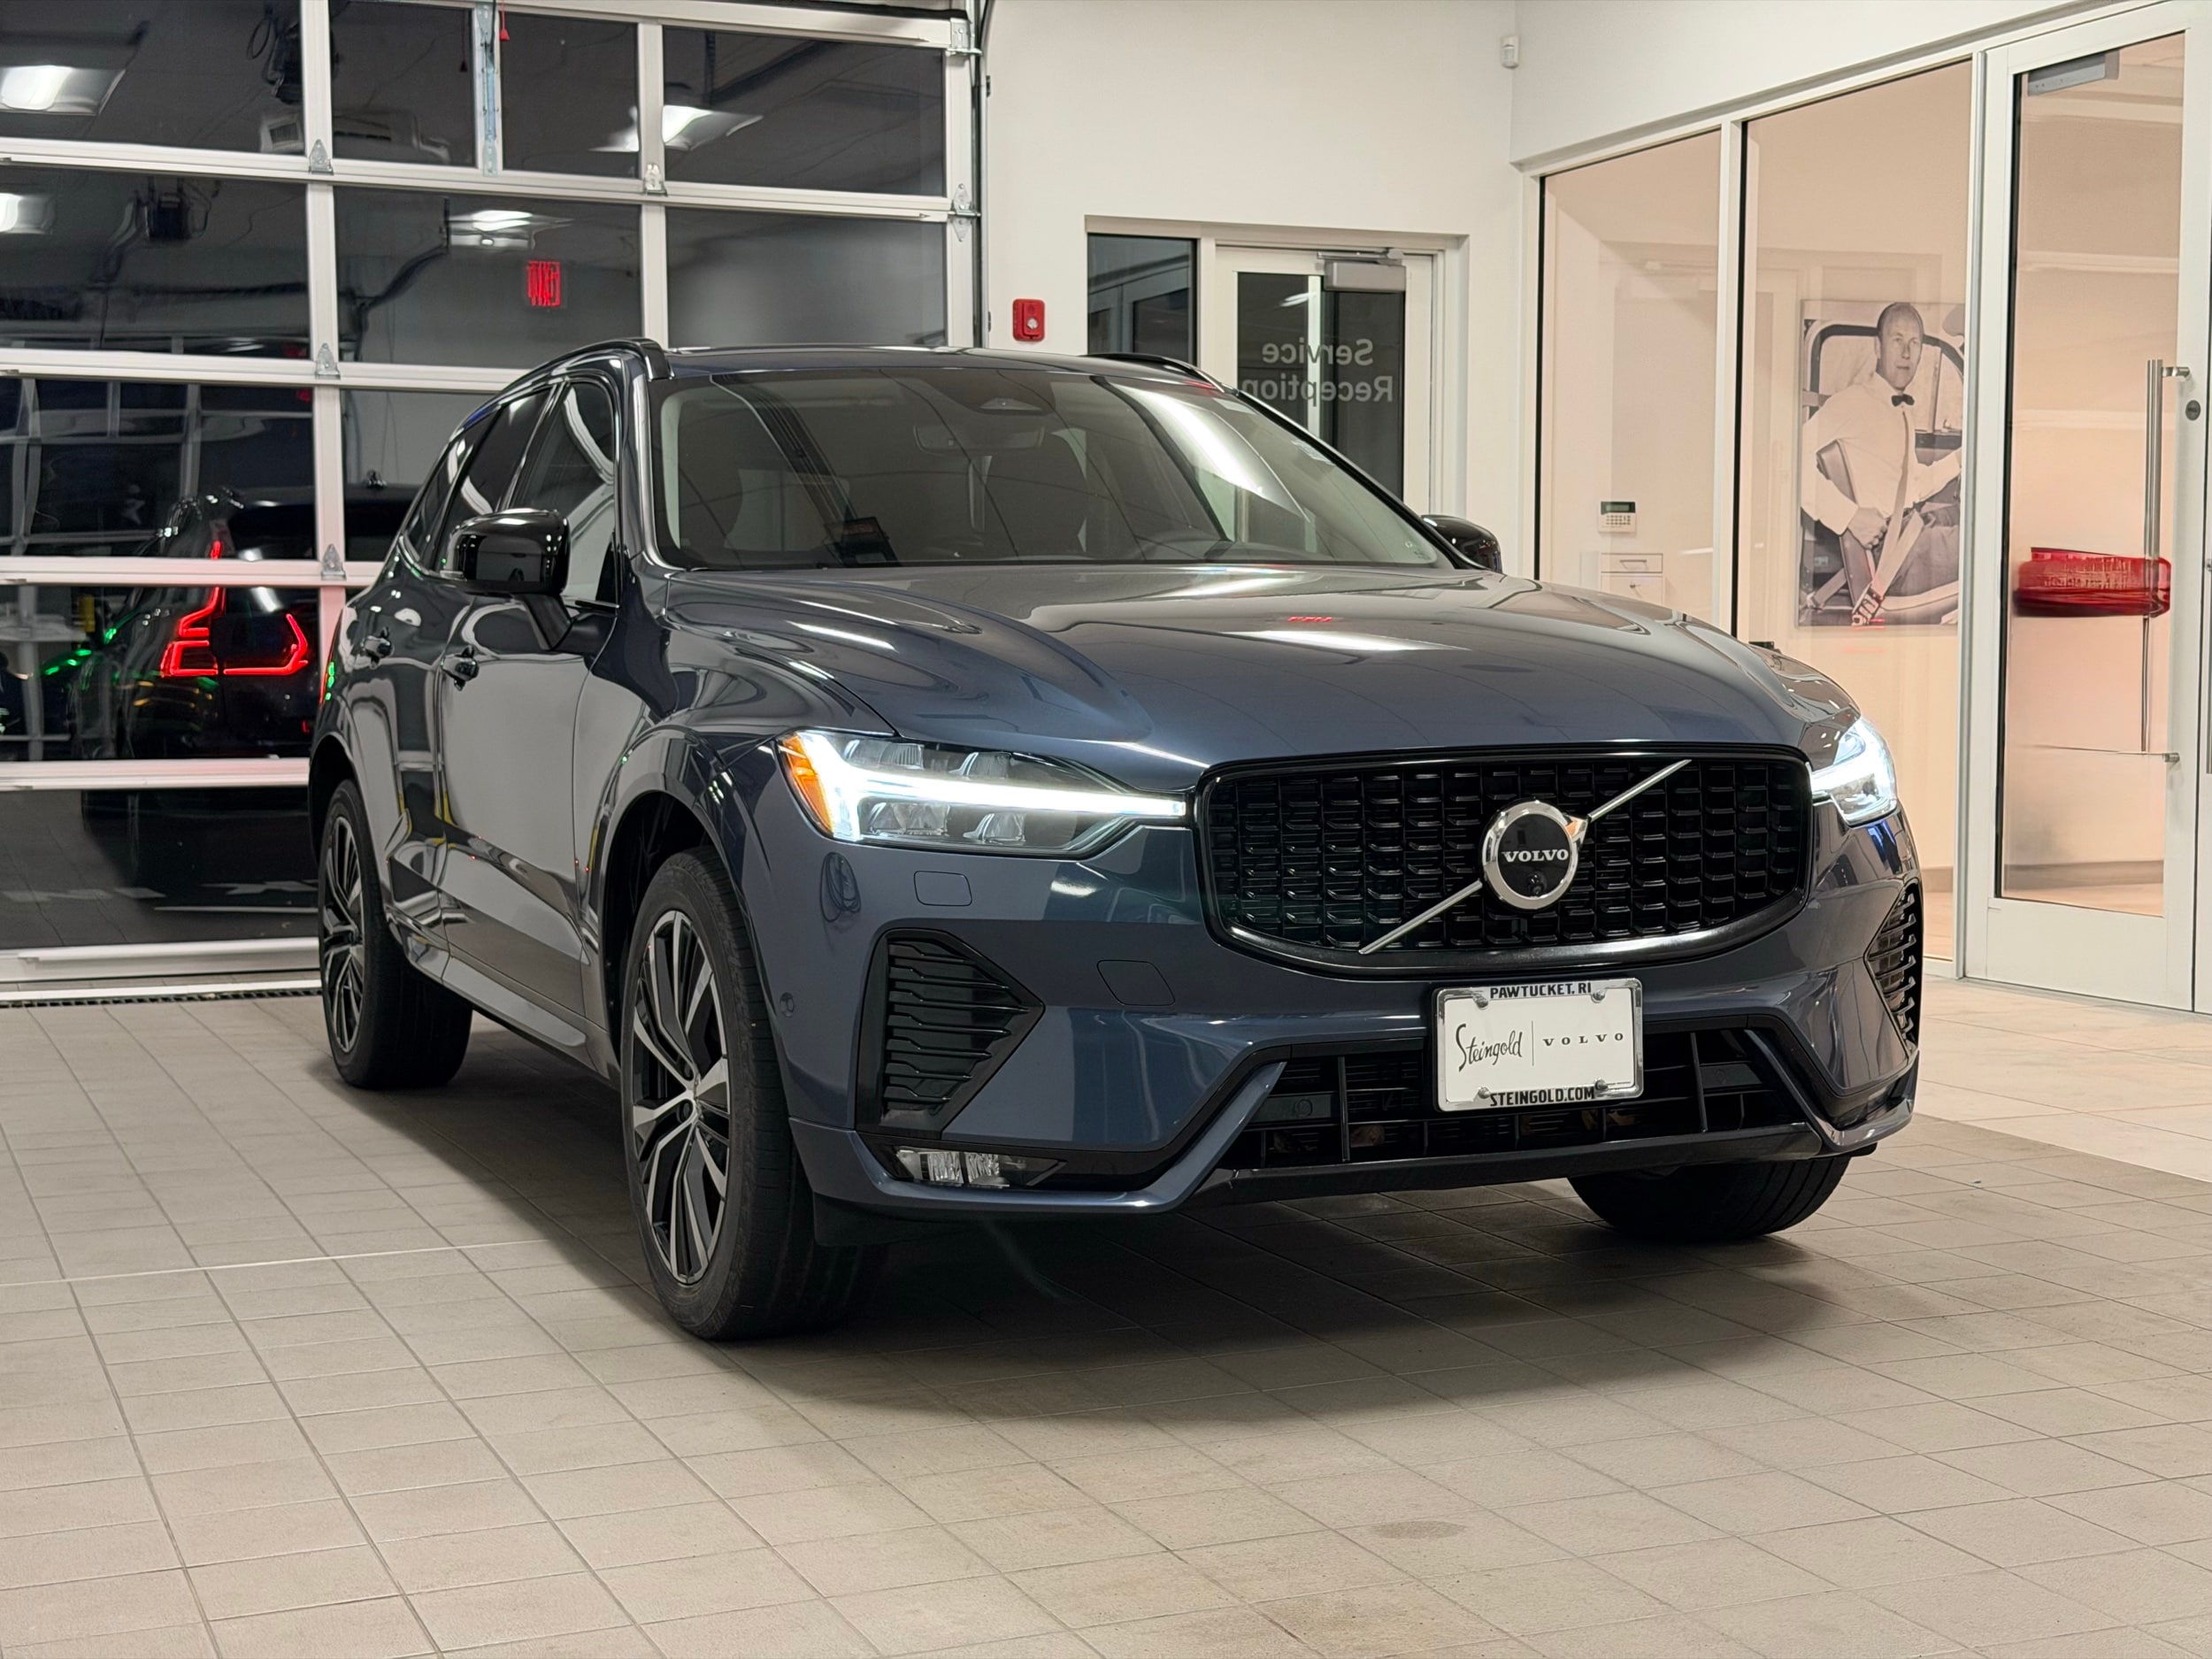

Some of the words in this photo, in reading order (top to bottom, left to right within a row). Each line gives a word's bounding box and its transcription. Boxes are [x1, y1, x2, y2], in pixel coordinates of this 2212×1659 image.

[1502, 849, 1570, 863] VOLVO
[1579, 982, 1592, 994] RI
[1455, 1023, 1523, 1071] Steingold
[1542, 1033, 1624, 1047] VOLVO
[1490, 1086, 1595, 1107] STEINGOLD.COM
